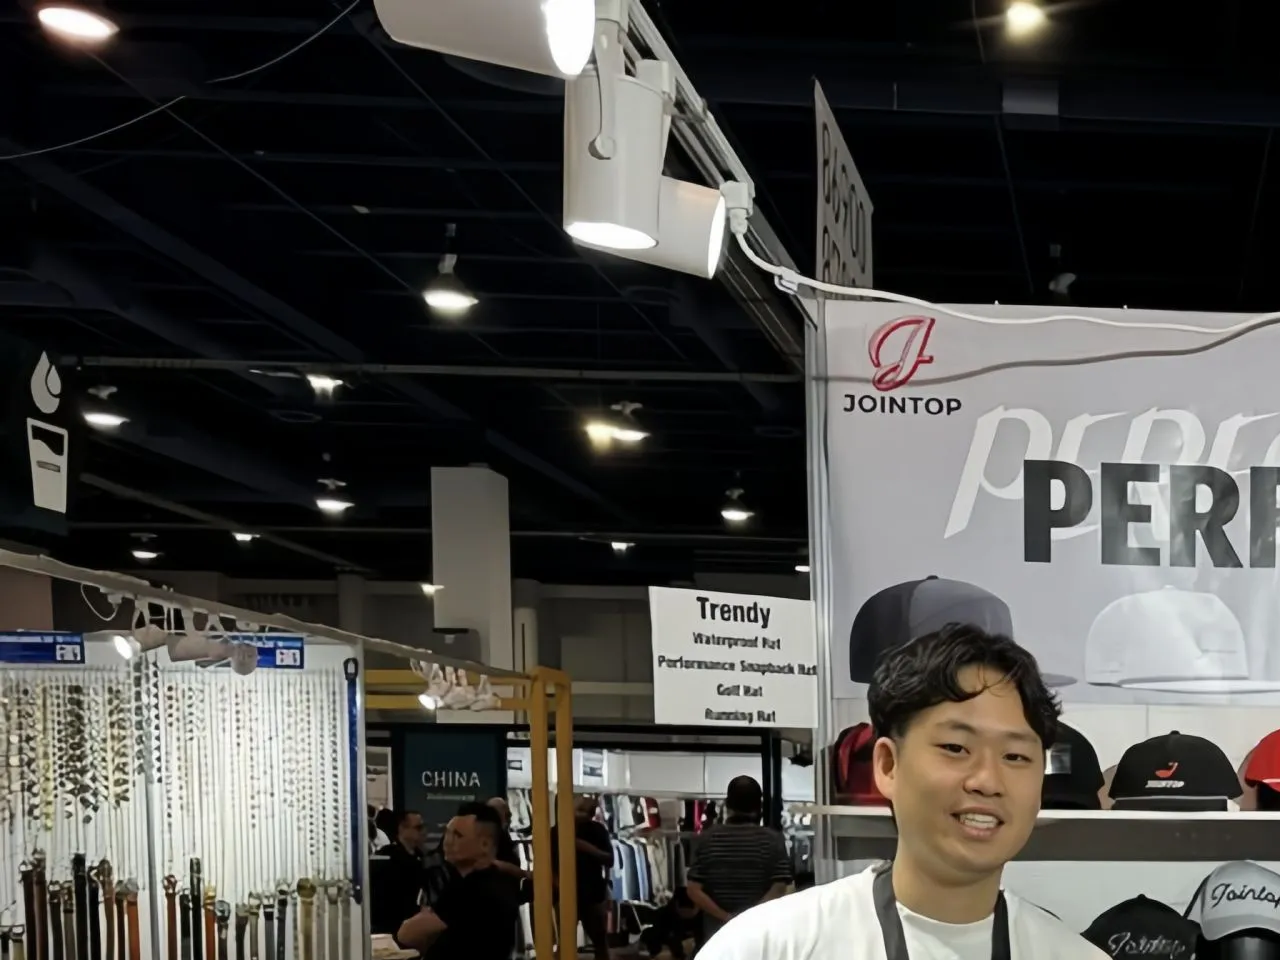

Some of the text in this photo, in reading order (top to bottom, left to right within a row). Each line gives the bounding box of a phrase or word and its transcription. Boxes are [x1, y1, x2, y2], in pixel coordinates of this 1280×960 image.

[843, 394, 962, 416] JOINTOP
[696, 596, 771, 629] Trendy
[421, 770, 481, 788] CHINA
